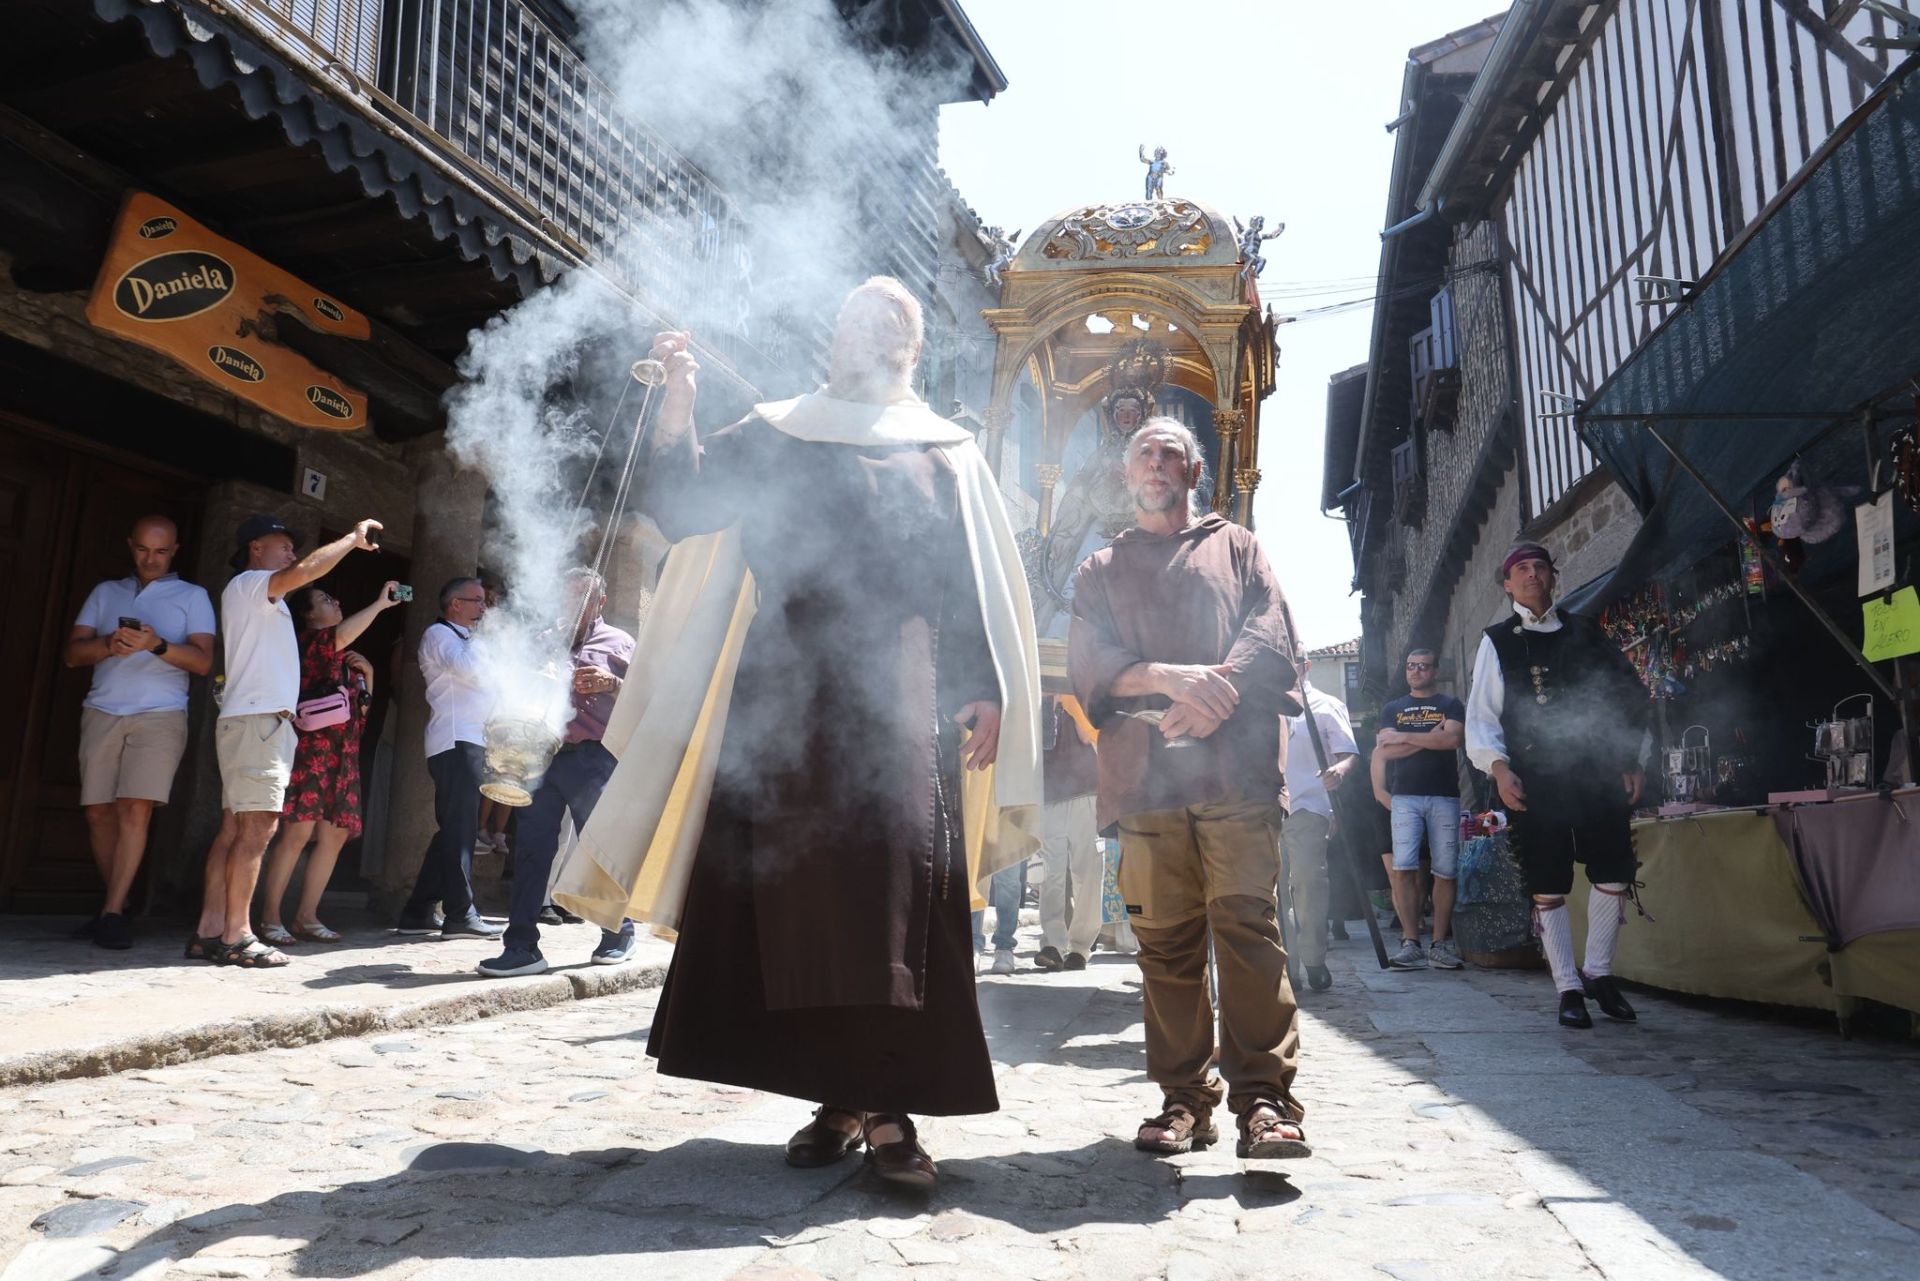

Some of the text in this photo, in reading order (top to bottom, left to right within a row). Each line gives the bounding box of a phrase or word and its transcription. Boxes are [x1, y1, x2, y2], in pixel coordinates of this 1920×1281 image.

[142, 219, 175, 238] Daniela
[127, 265, 228, 314] Daniela
[317, 300, 342, 320] Daniela
[215, 346, 260, 381] Daniela
[312, 386, 350, 418] Daniela
[310, 473, 321, 493] 7
